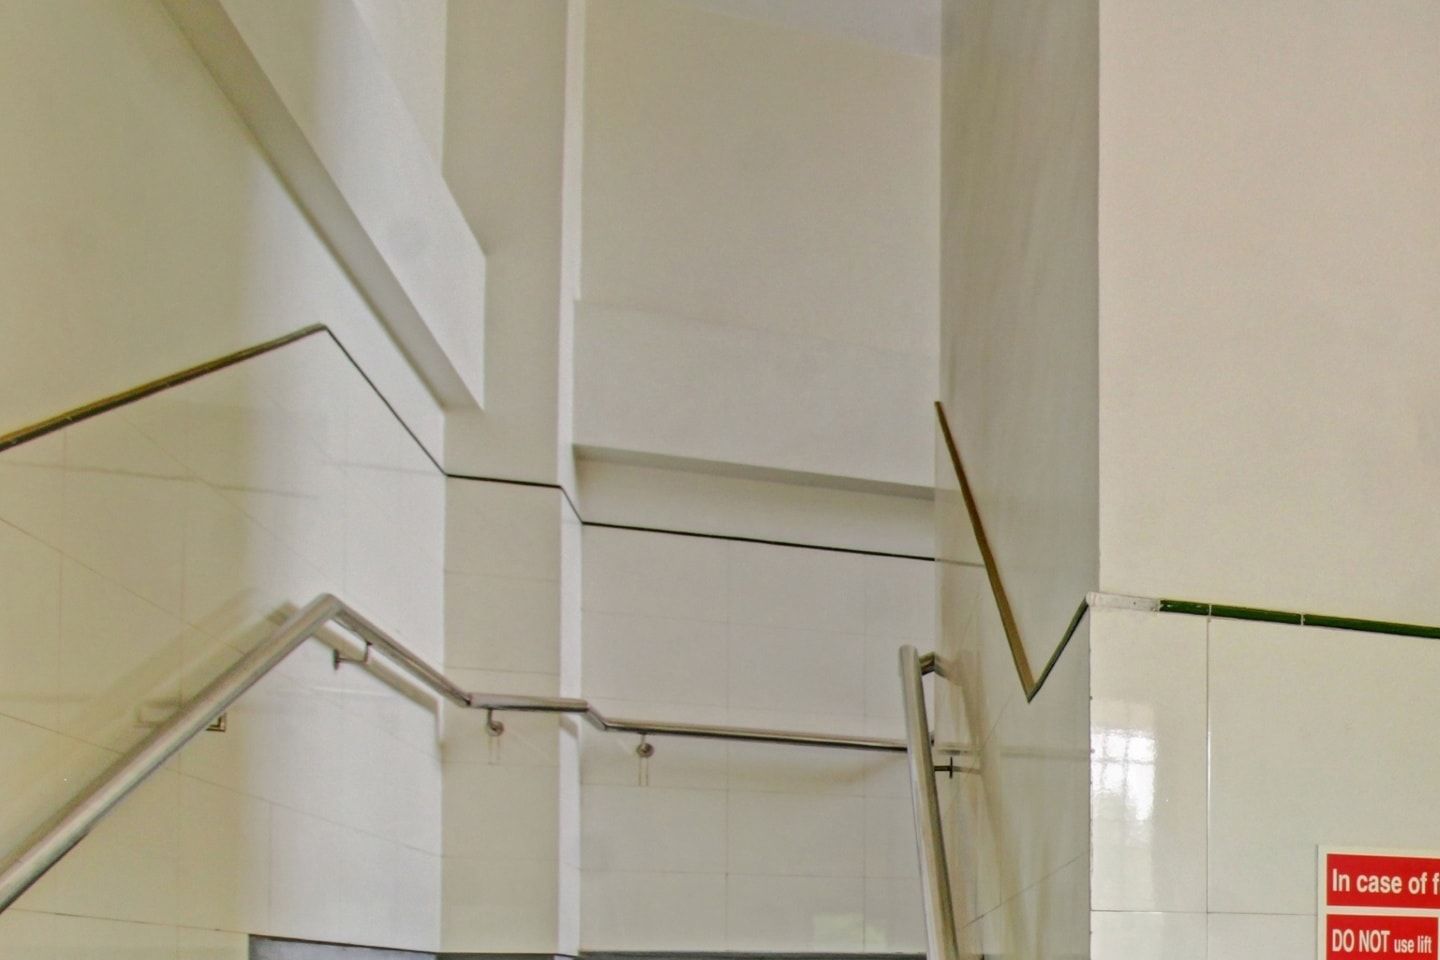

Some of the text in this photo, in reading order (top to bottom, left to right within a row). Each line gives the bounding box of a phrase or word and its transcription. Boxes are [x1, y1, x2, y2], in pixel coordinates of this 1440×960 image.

[1332, 868, 1350, 892] In
[1356, 874, 1402, 894] case
[1408, 872, 1427, 895] of
[1332, 929, 1432, 954] DO NOT use lift
